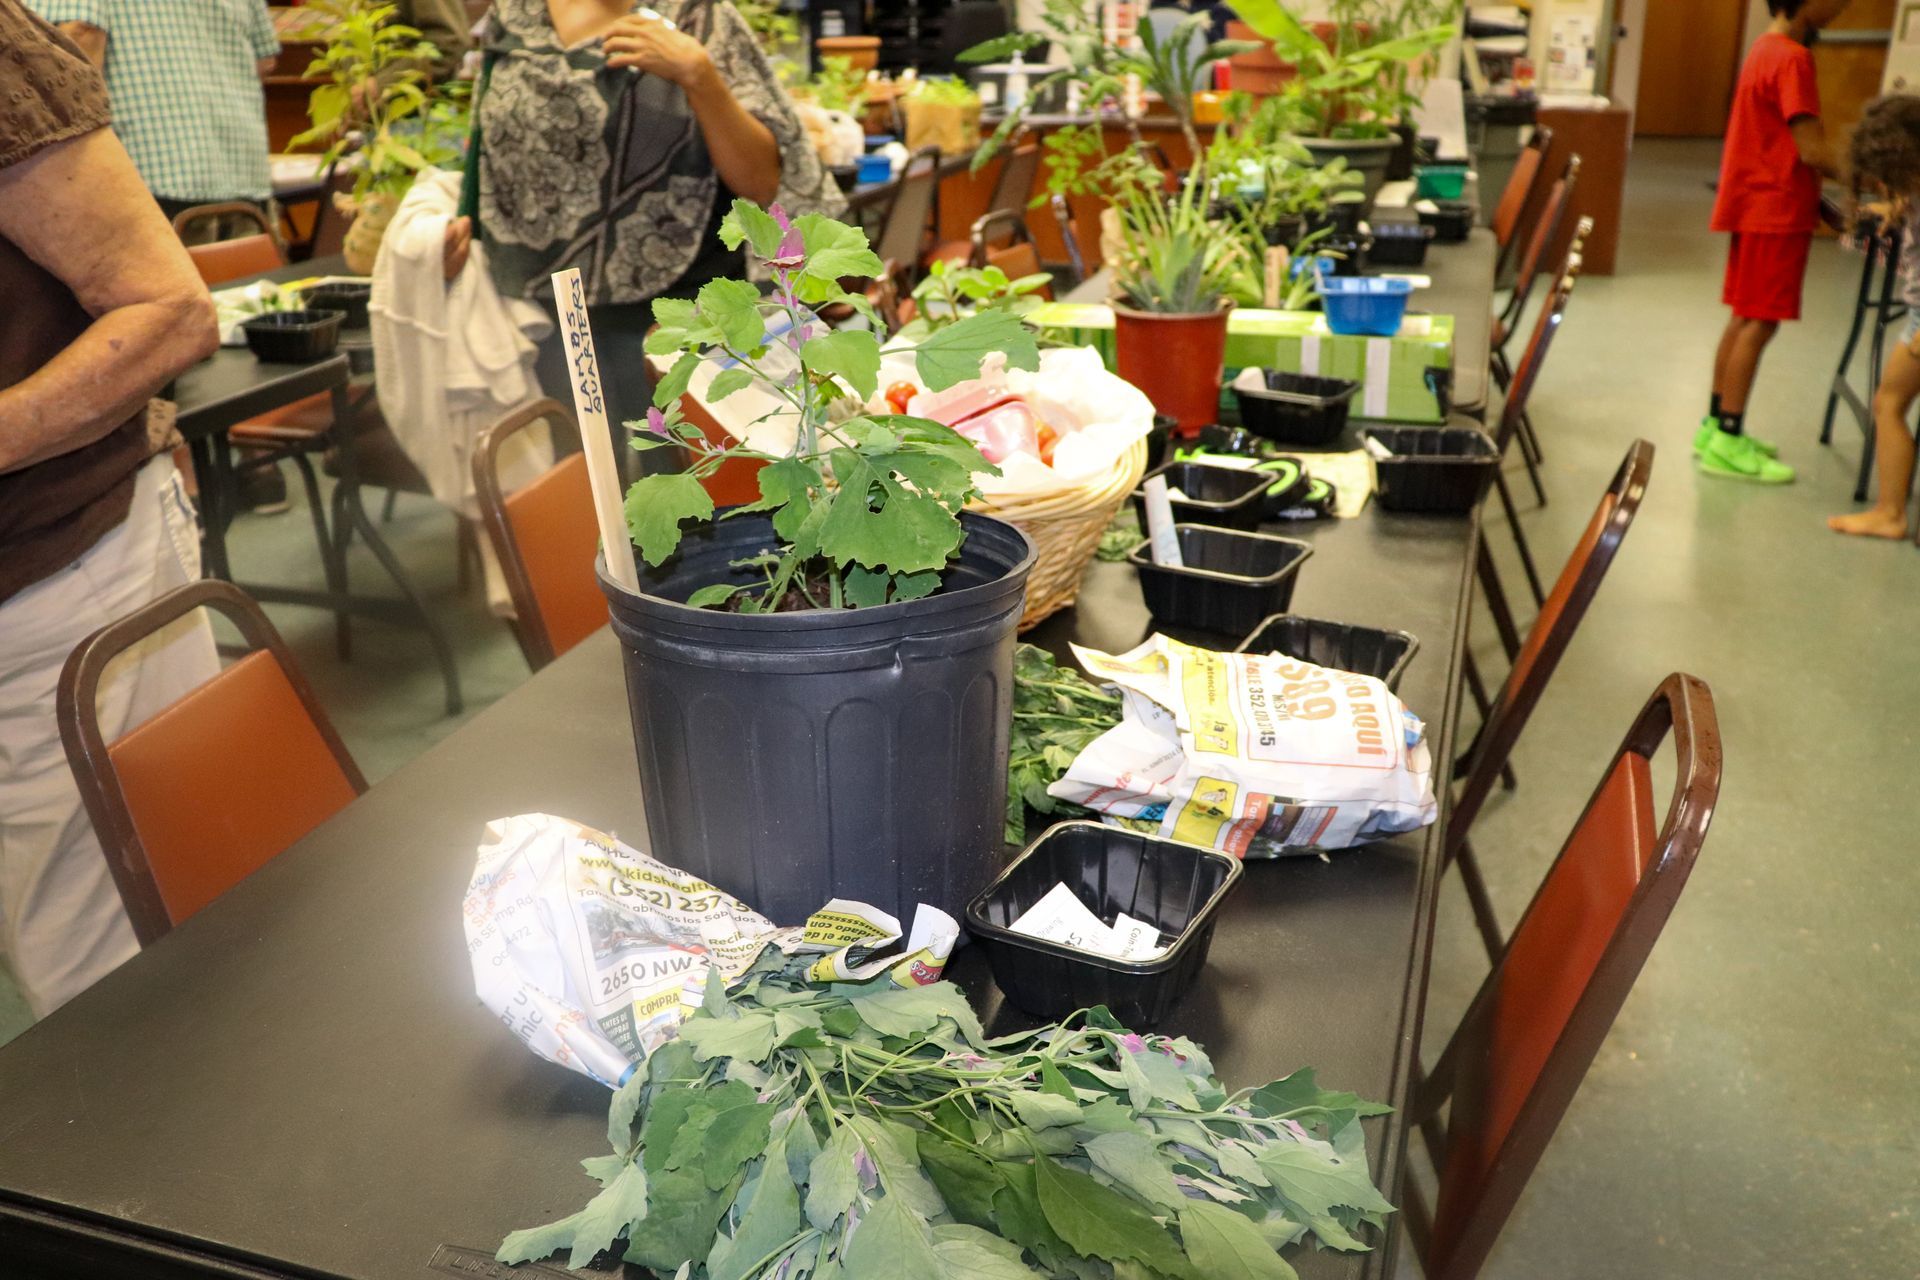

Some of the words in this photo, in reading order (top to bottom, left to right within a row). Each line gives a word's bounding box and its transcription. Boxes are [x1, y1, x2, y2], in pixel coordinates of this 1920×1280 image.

[571, 277, 602, 414] QUARTERS
[1350, 703, 1388, 756] AQUÍ
[601, 961, 646, 995] 2650
[652, 956, 693, 978] NW
[639, 992, 680, 1016] COMPRA
